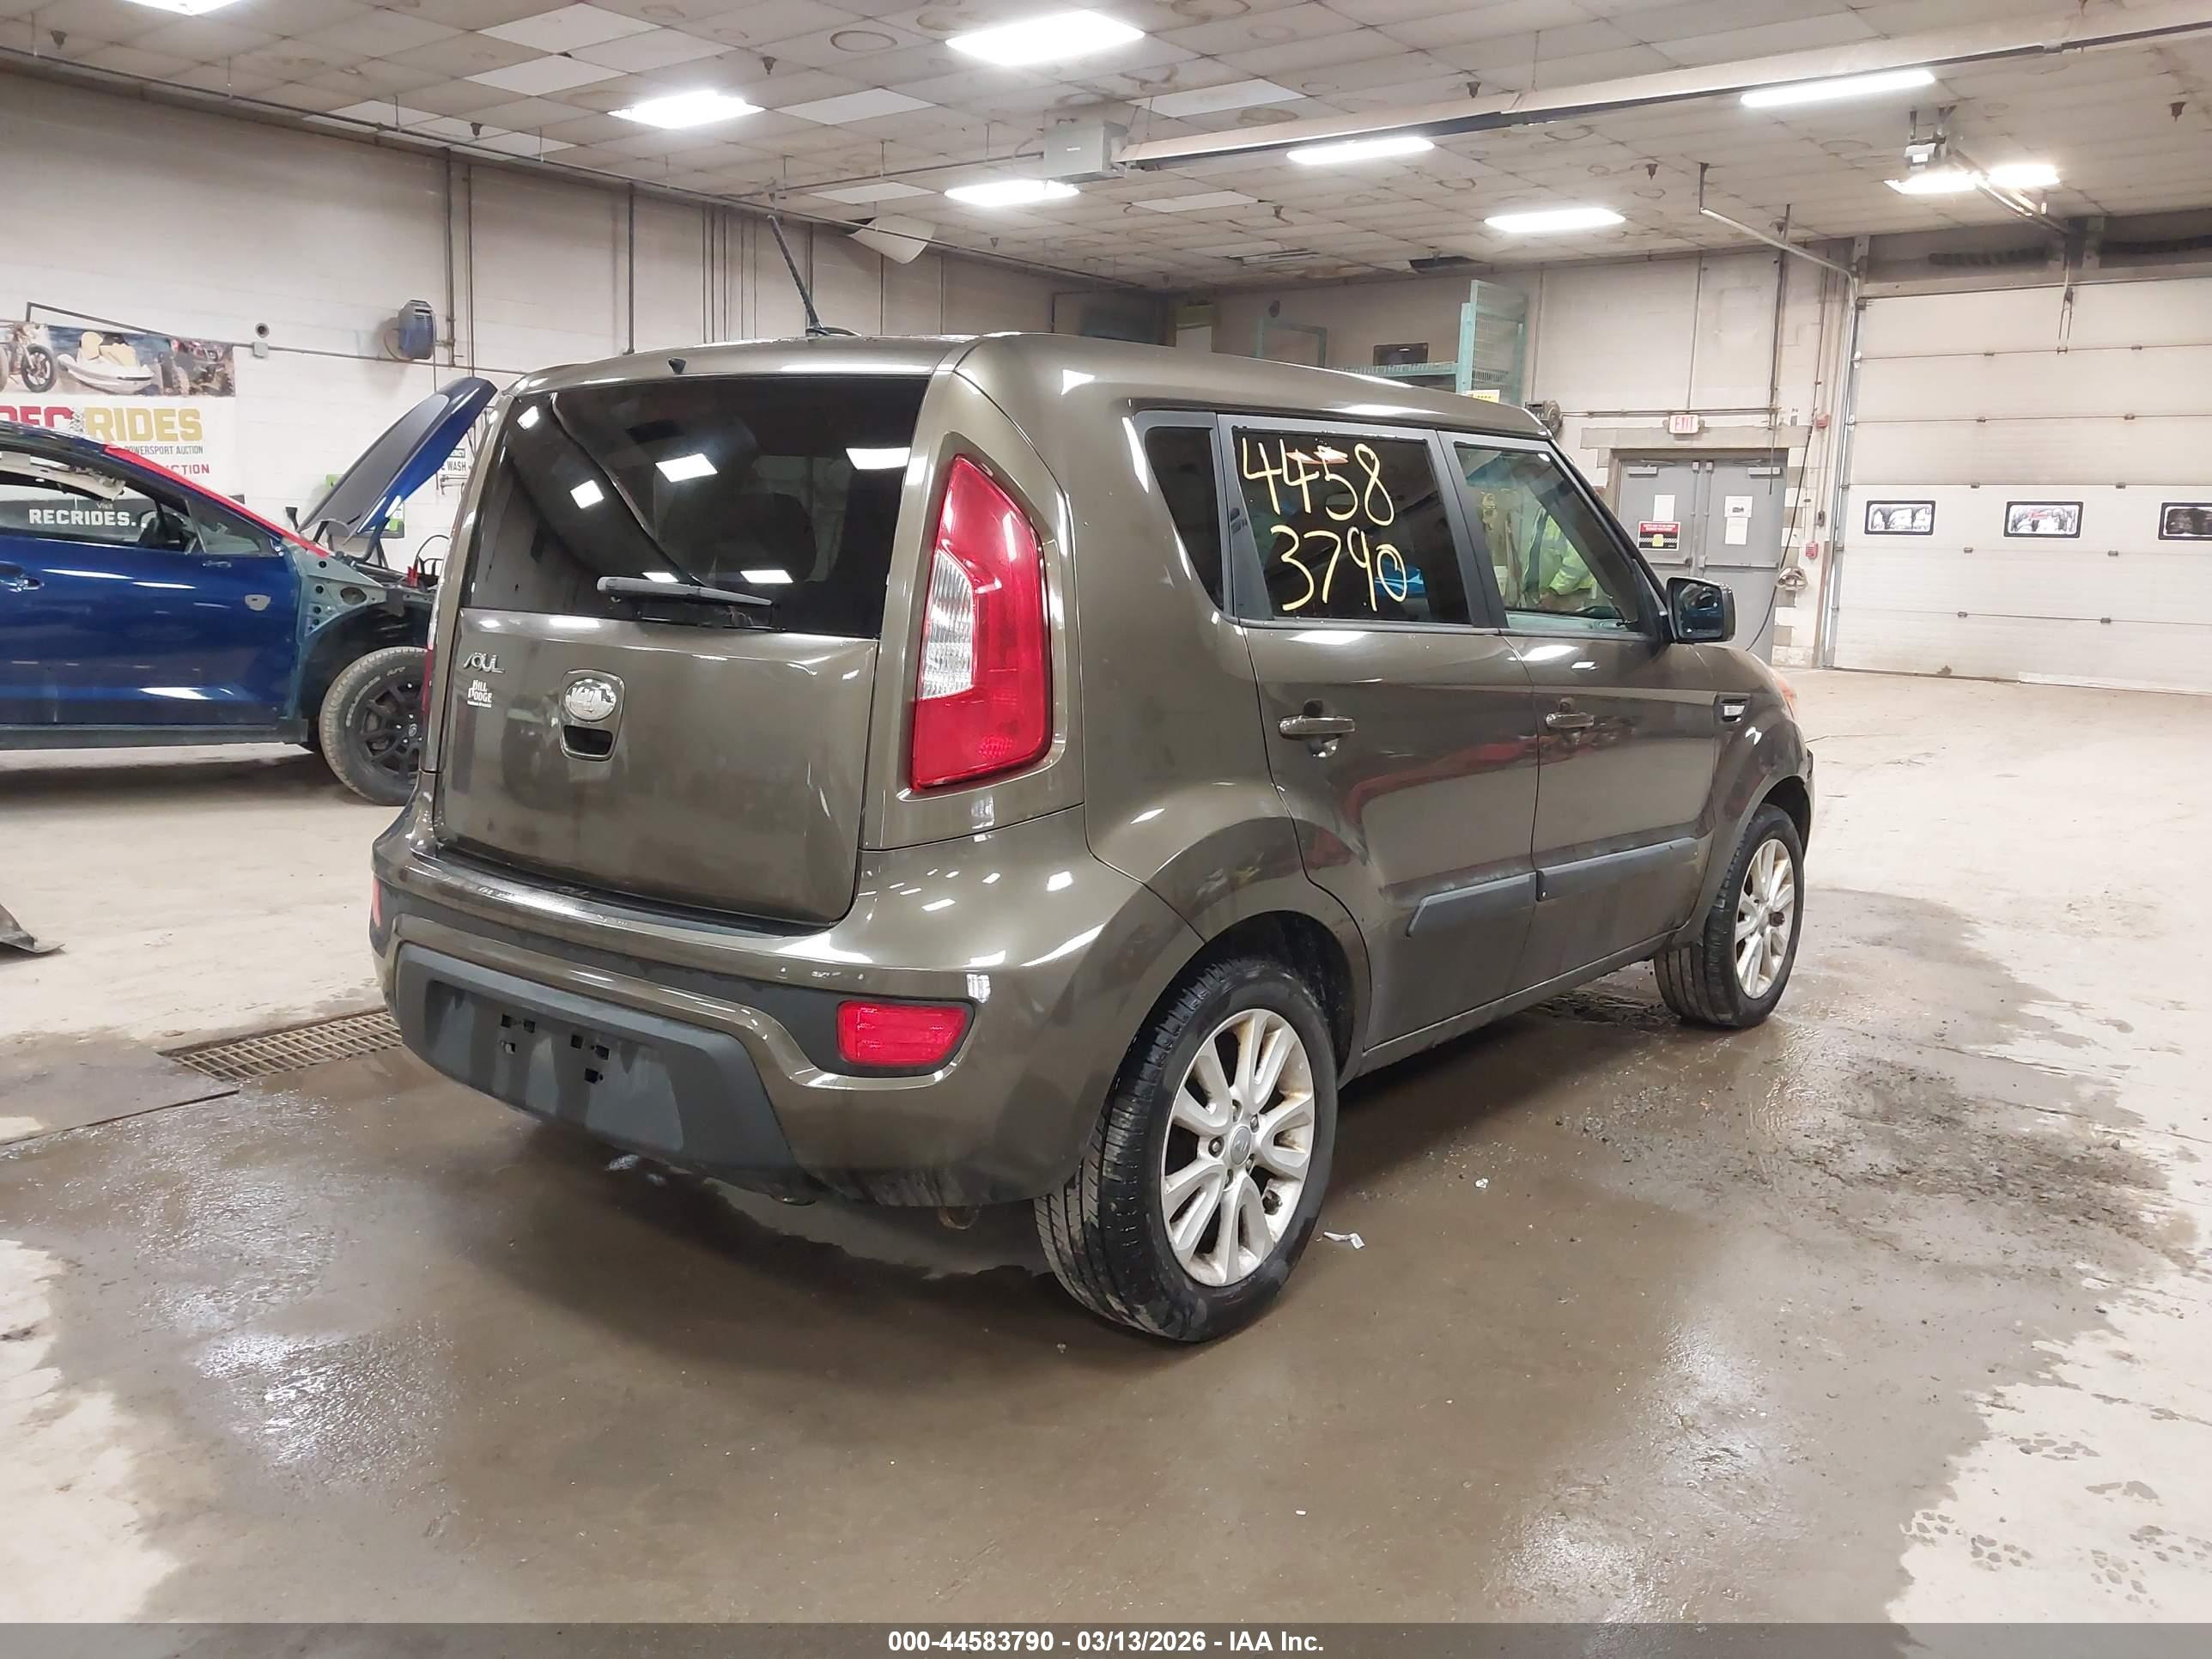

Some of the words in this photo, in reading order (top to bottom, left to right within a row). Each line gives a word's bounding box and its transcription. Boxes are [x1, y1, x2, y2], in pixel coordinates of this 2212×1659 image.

[85, 407, 202, 441] RIDES
[447, 460, 466, 471] WASH
[1242, 437, 1395, 526] 4458
[1271, 525, 1407, 611] 3790
